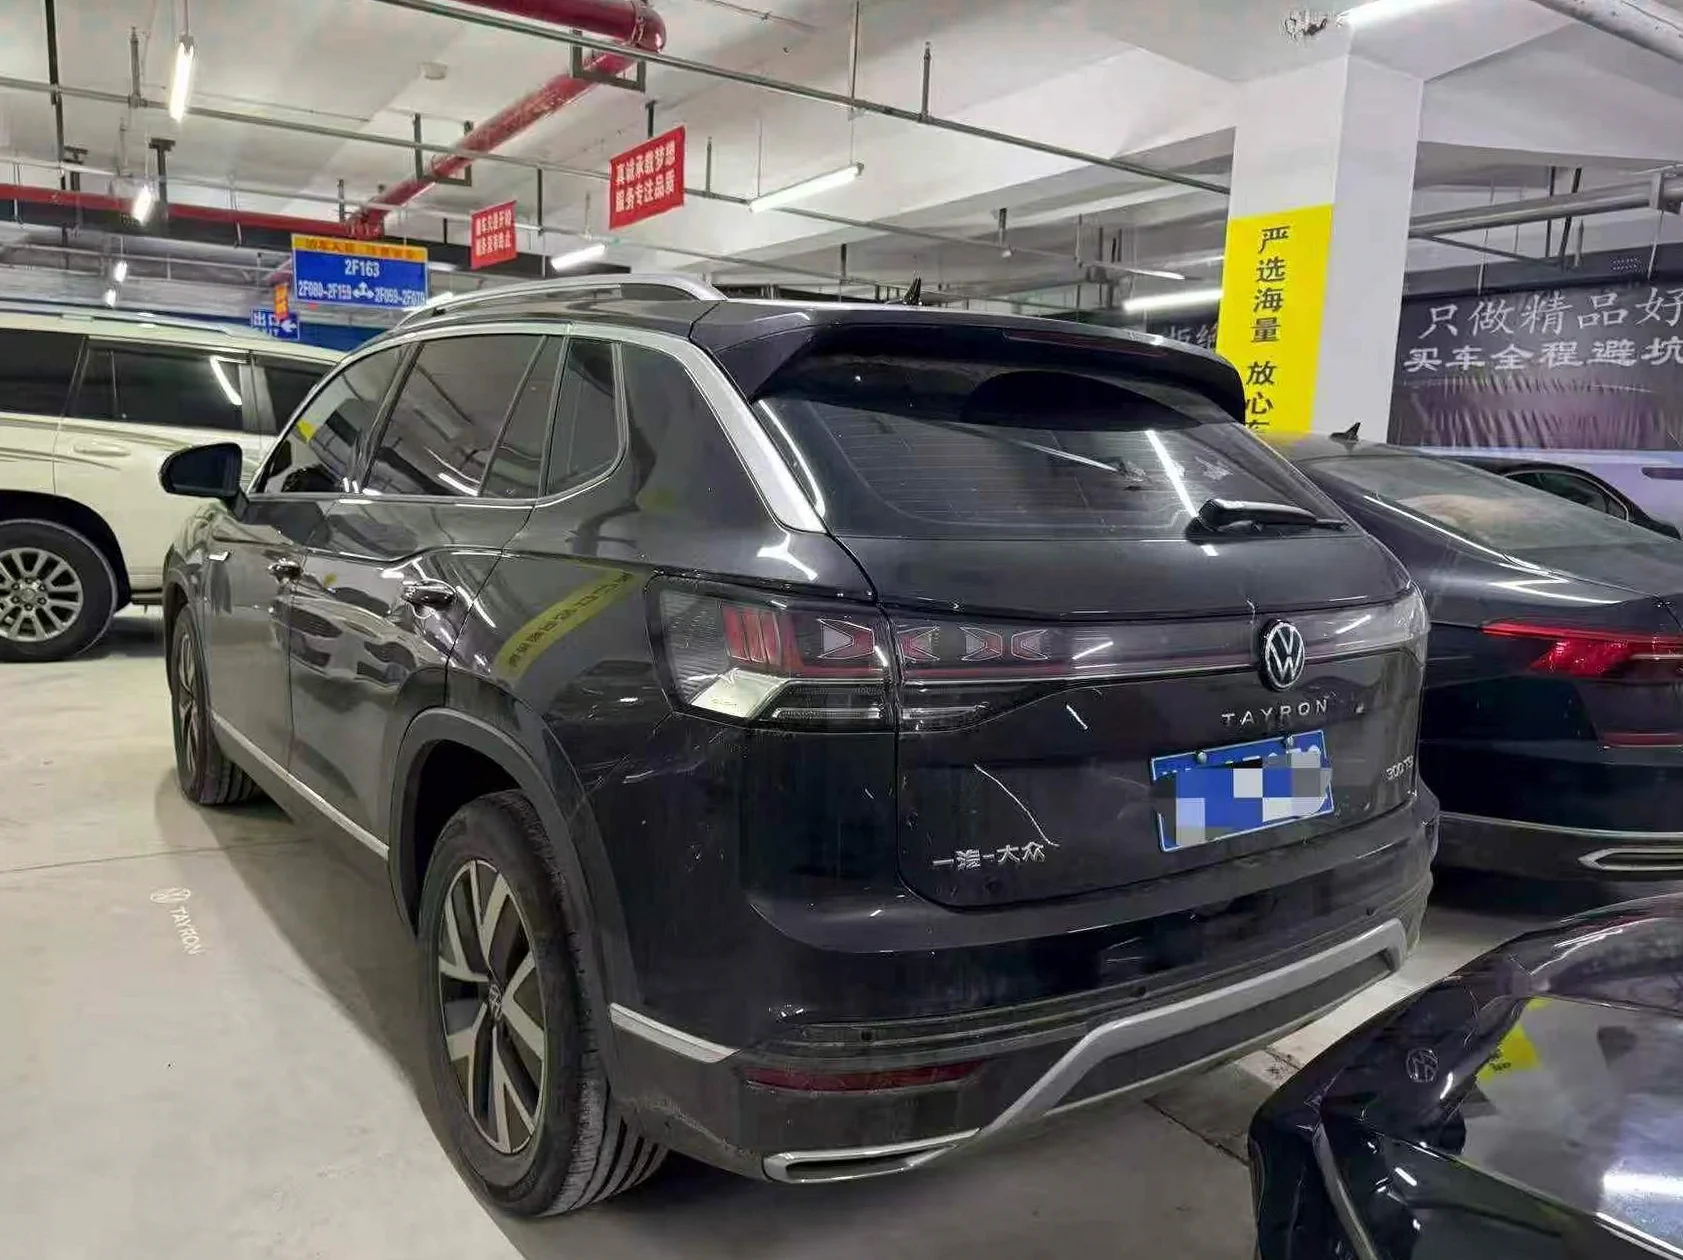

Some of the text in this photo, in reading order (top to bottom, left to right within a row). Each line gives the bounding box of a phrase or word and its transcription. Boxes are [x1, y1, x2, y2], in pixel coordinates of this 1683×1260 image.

[345, 259, 381, 277] 2F163
[1250, 225, 1291, 343] 严选海量
[1418, 287, 1683, 340] 只做精品好
[1403, 336, 1683, 374] 买车全程避坑
[1221, 698, 1328, 726] TAYRON
[170, 906, 206, 955] TAYRON
